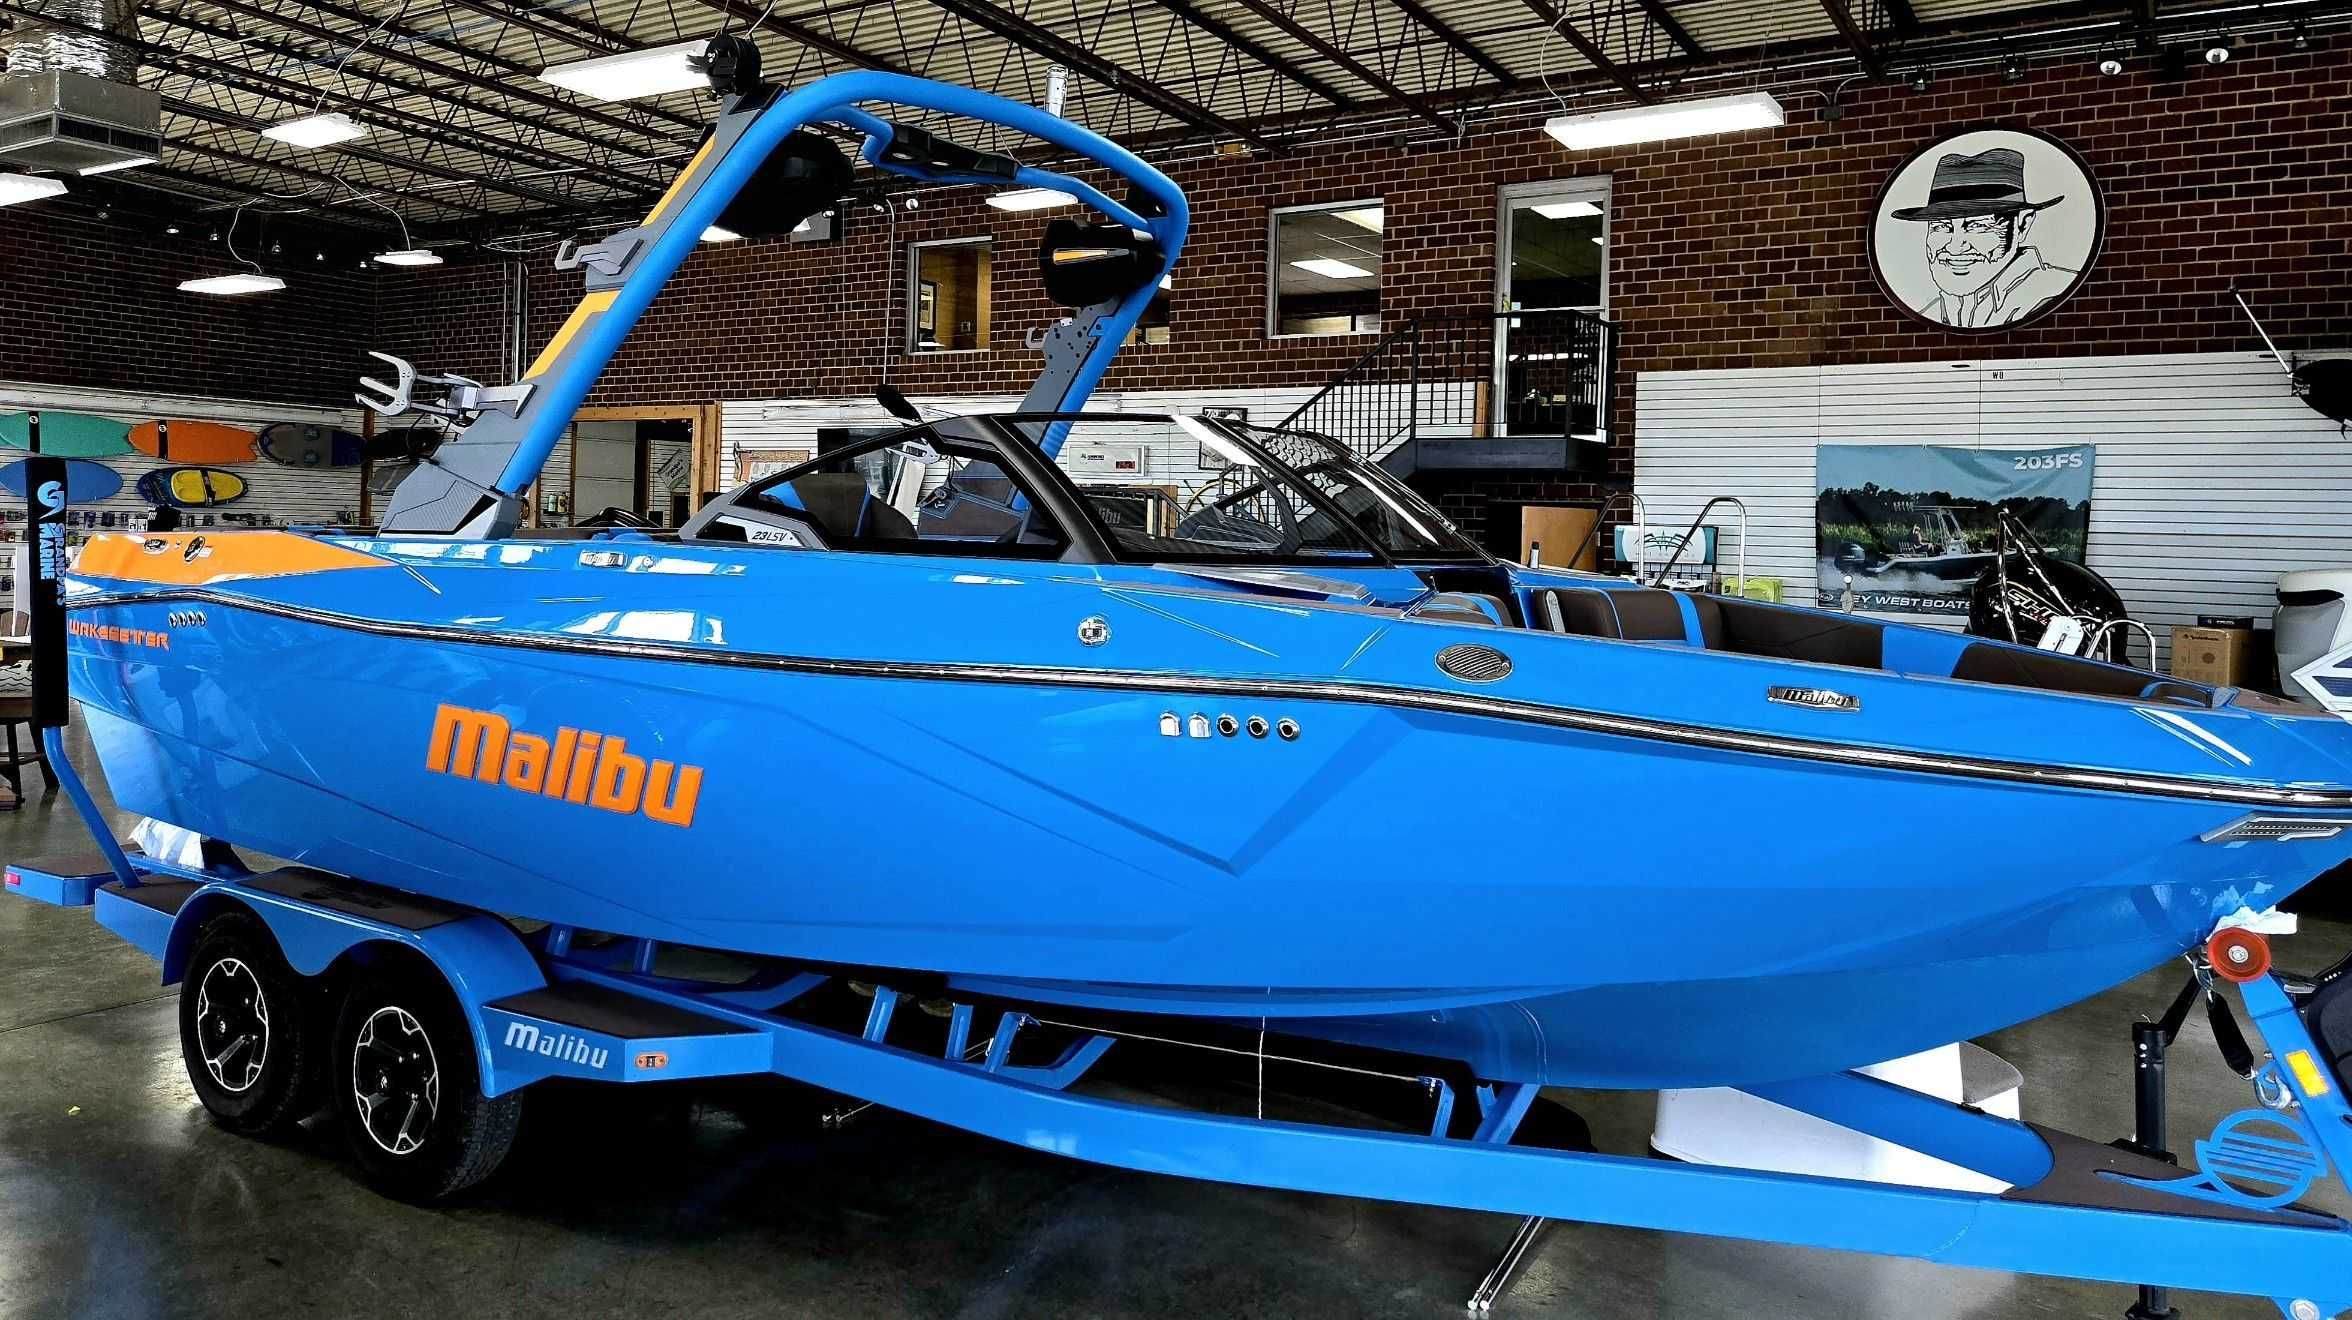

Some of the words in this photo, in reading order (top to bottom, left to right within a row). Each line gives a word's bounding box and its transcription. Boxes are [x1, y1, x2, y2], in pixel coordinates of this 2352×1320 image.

[2014, 453, 2083, 470] 203FS
[751, 531, 788, 542] 23LSV
[38, 522, 56, 580] MARINE
[1875, 595, 1921, 607] WEST
